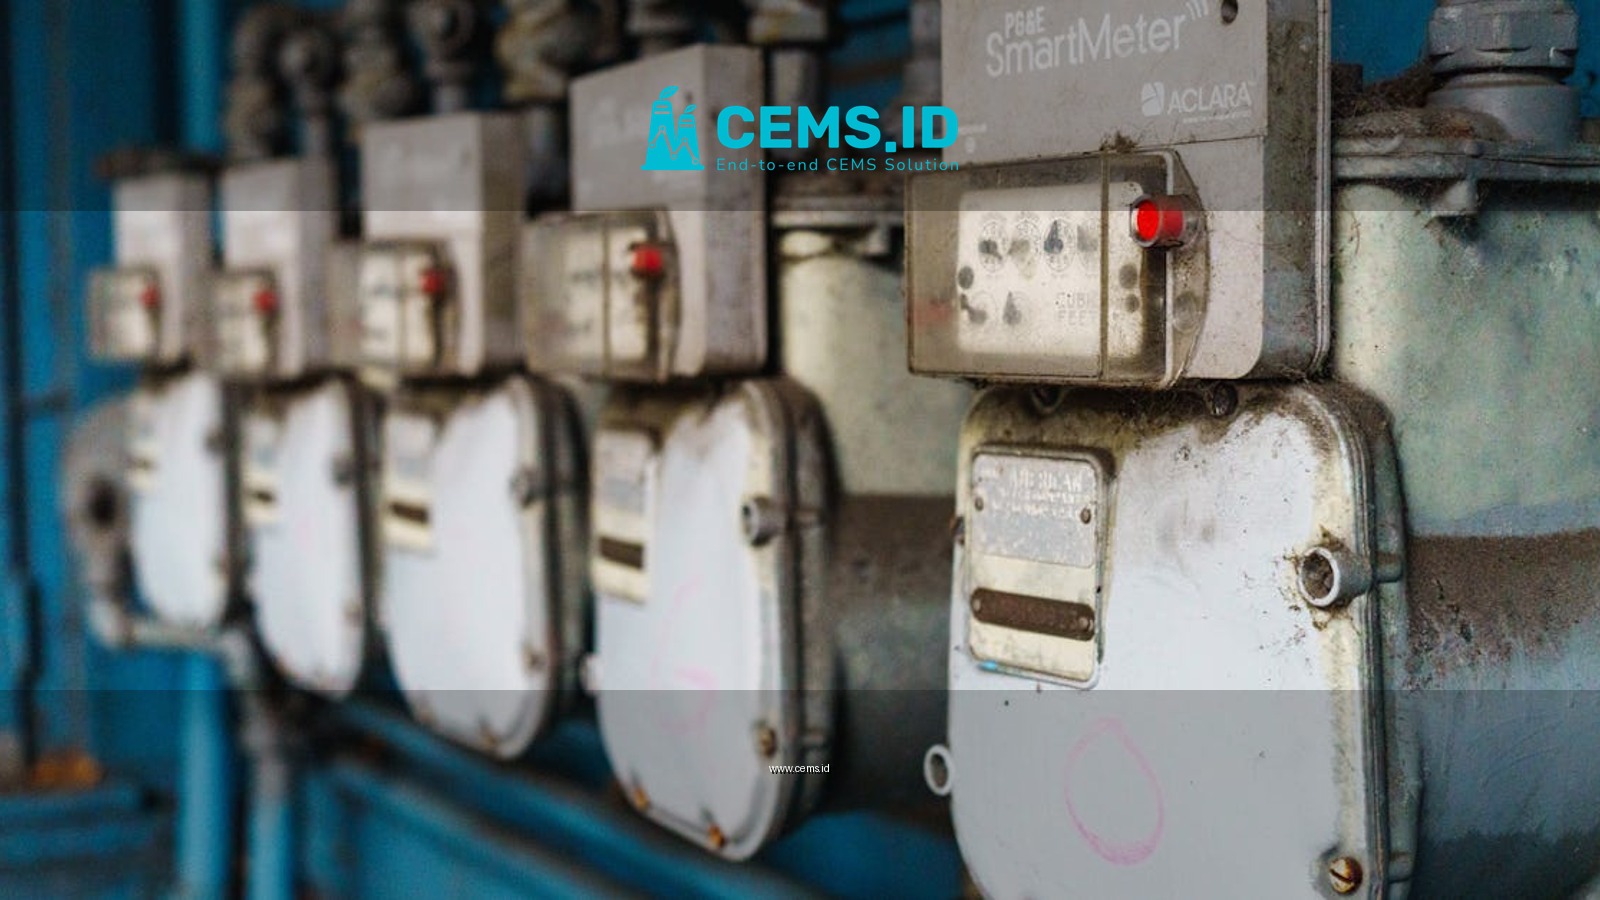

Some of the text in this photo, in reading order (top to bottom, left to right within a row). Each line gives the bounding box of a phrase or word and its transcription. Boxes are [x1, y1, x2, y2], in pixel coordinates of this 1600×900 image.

[1004, 6, 1046, 39] PG&E
[986, 13, 1186, 77] SmartMeter
[1167, 81, 1252, 115] ACLARA
